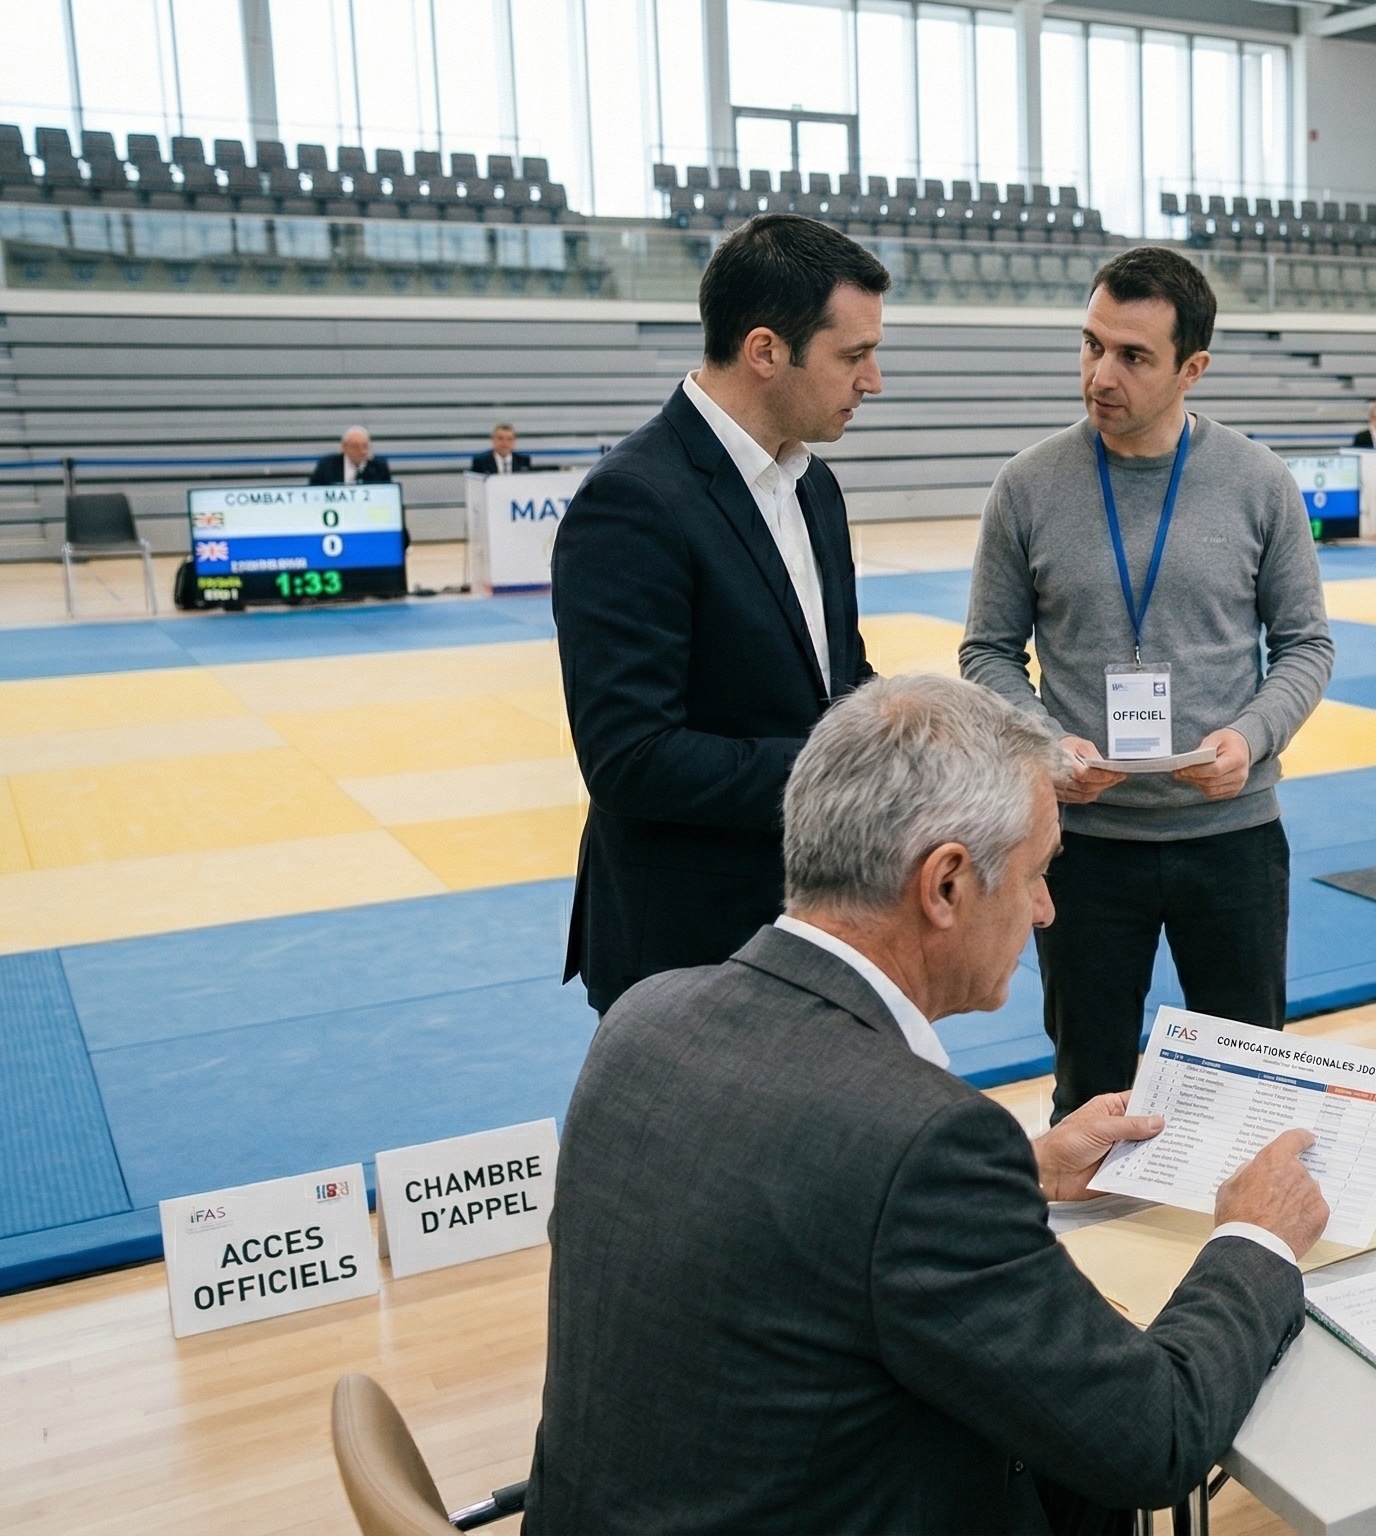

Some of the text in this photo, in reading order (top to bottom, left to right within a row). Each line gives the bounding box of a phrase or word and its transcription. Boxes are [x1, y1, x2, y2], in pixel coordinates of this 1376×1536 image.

[225, 491, 295, 507] COMBAT
[302, 492, 308, 504] 1
[324, 490, 357, 503] MAT
[363, 490, 370, 502] 2
[322, 509, 339, 527] 0
[322, 534, 344, 557] 0
[275, 570, 343, 597] 1:33
[1113, 710, 1166, 721] OFFICIEL
[1166, 1024, 1198, 1041] IFAS
[1293, 1051, 1355, 1072] RÉGIONALES
[1356, 1064, 1376, 1076] JDO
[405, 1156, 542, 1203] CHAMBRE
[421, 1191, 538, 1234] D'APPEL
[220, 1226, 324, 1268] ACCES
[194, 1254, 358, 1310] OFFICIELS
